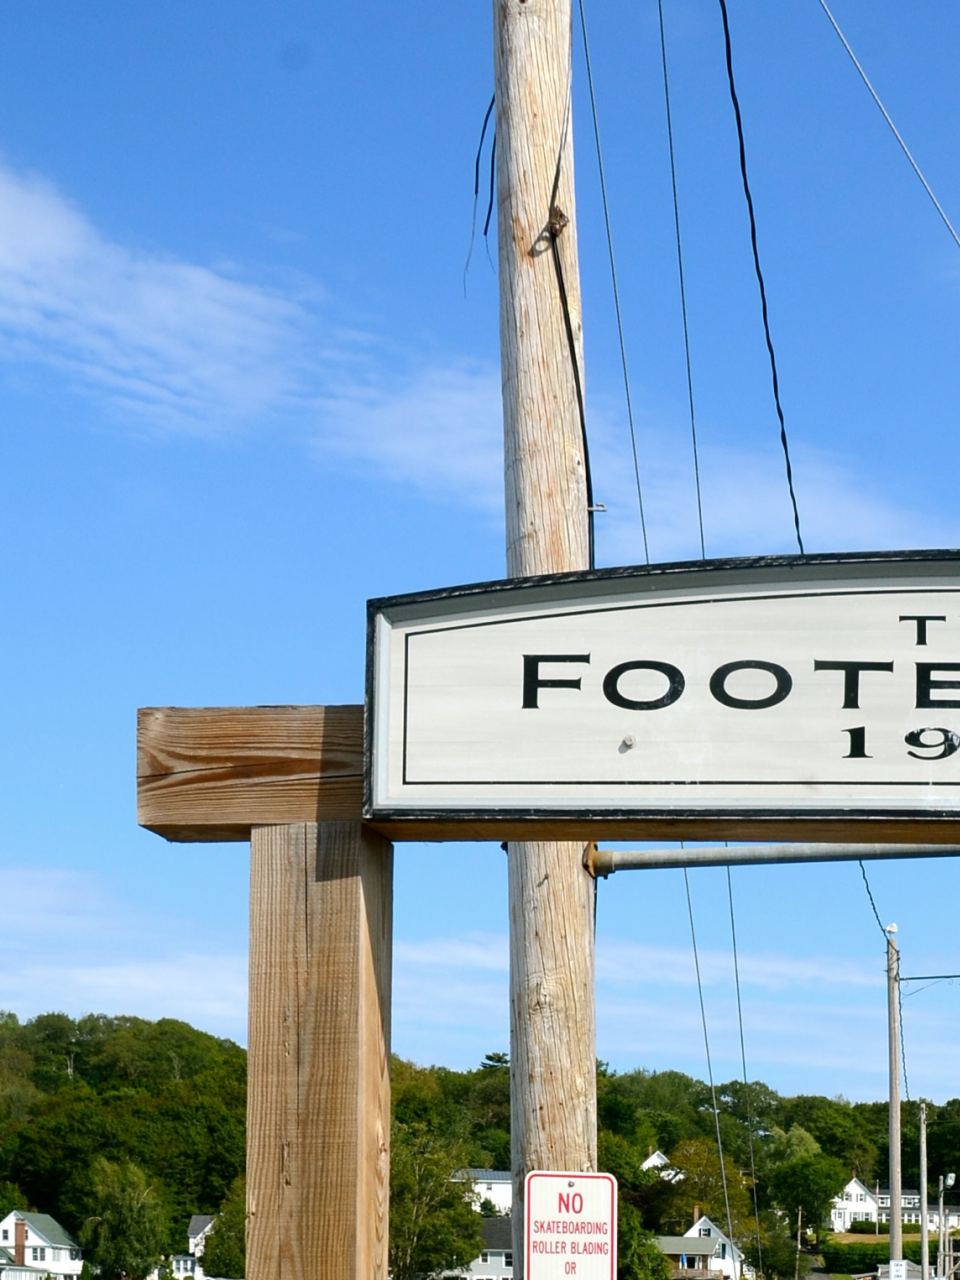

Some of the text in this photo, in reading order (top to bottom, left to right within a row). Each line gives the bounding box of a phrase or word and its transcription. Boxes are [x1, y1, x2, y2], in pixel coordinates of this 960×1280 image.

[558, 1192, 584, 1214] NO
[533, 1220, 608, 1235] SKATEBOARDING
[532, 1240, 609, 1255] ROLLER BLADING
[564, 1261, 577, 1275] OR
